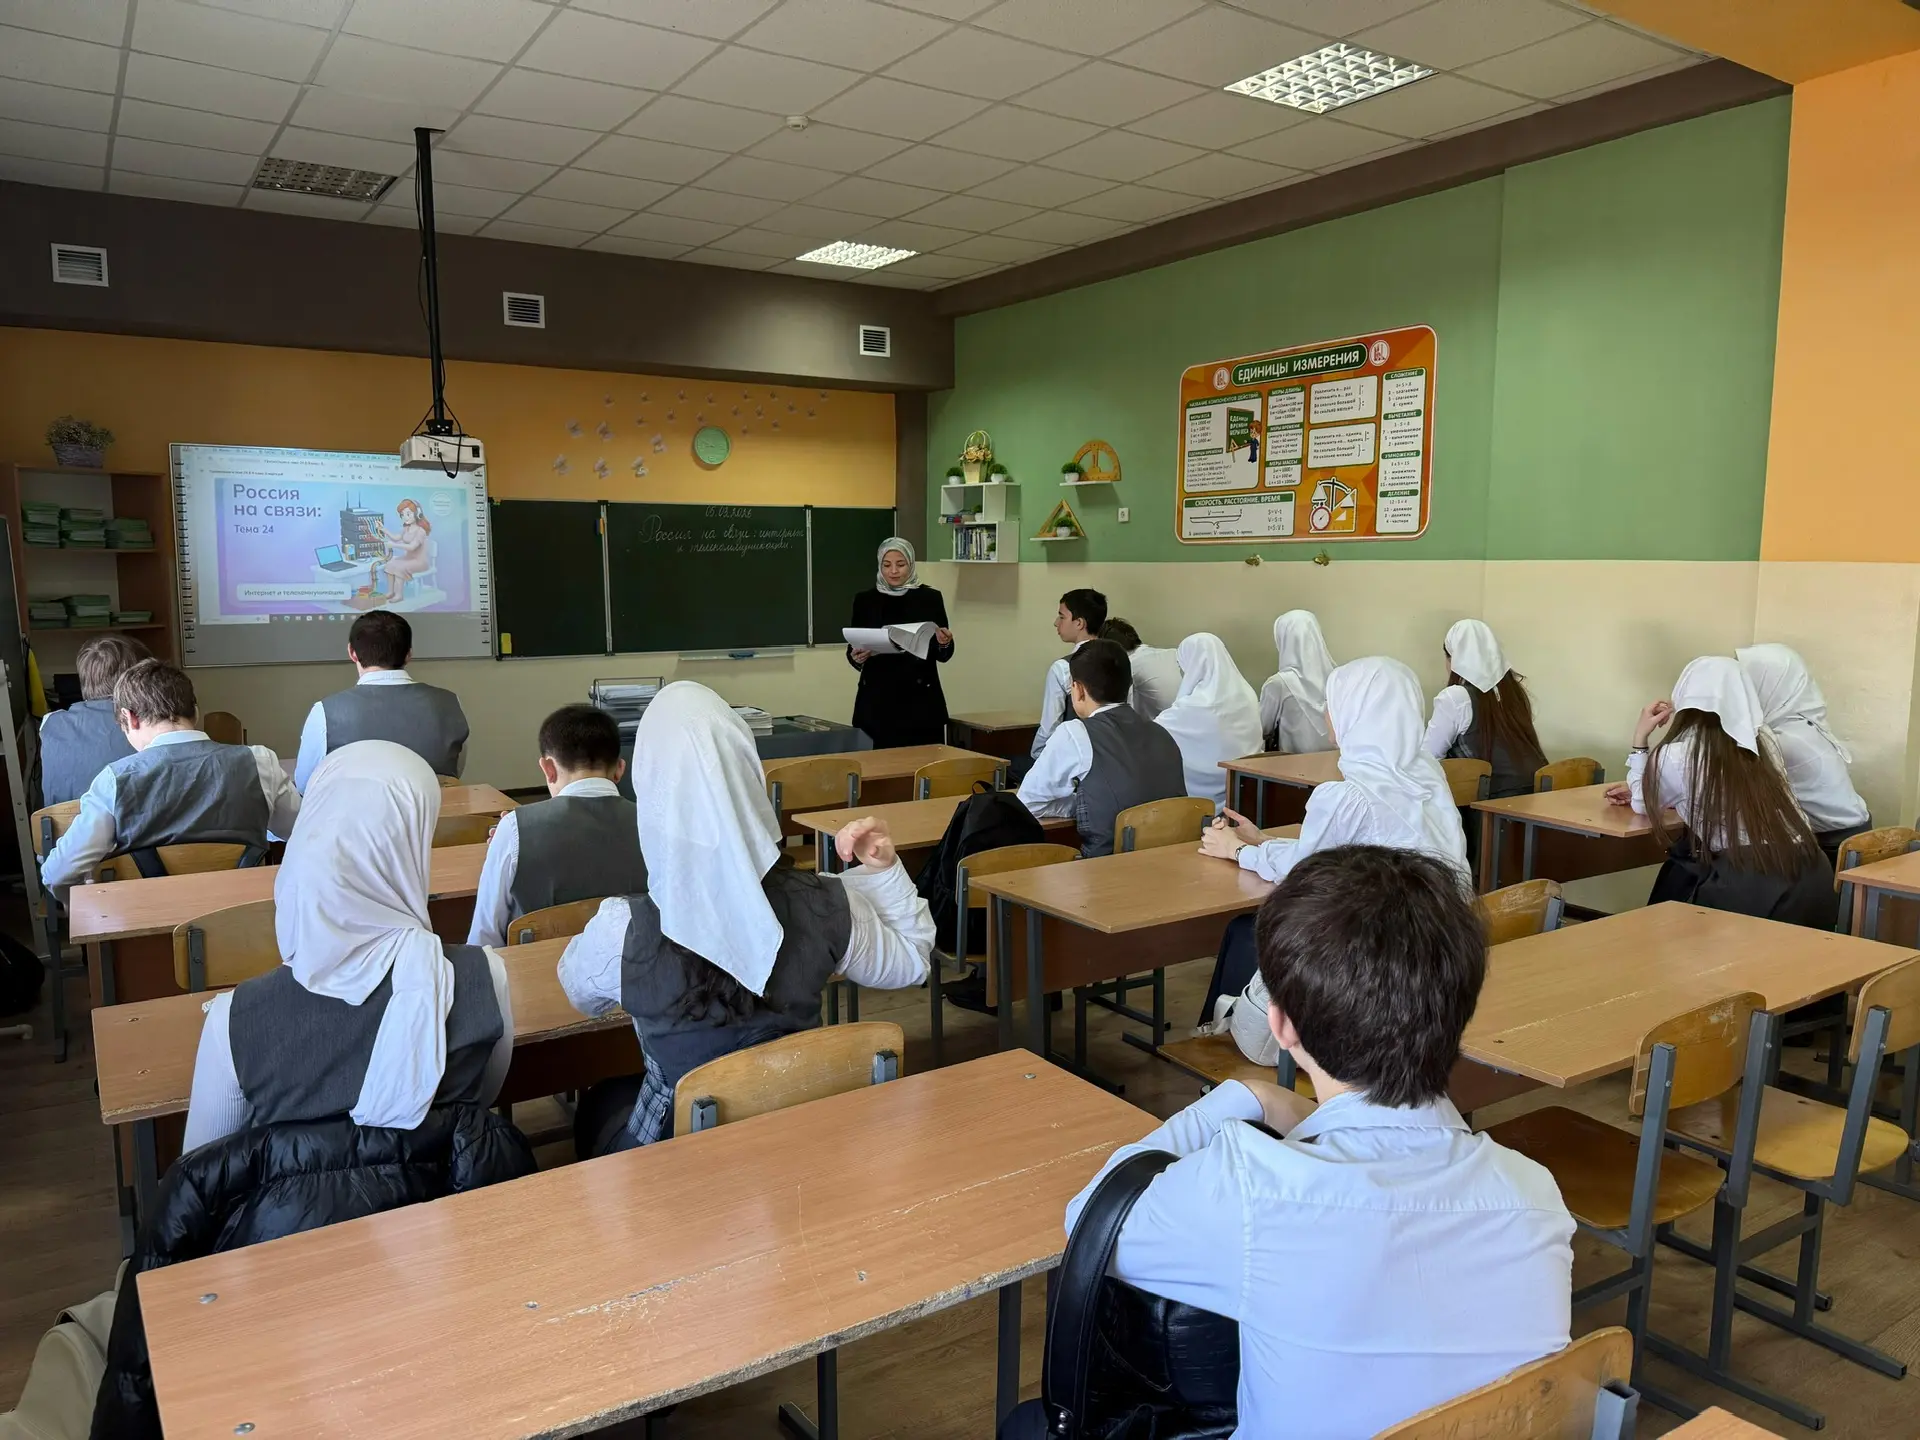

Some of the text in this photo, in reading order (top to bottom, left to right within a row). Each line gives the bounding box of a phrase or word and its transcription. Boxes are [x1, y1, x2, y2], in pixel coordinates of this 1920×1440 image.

[1238, 351, 1359, 382] ЕДИНИЦЫ ИЗМЕРЕНИЯ
[233, 484, 300, 500] Россия
[1224, 497, 1260, 505] РАССТОЯНИЕ.
[234, 504, 322, 517] на связи:
[234, 524, 274, 534] Тема 24
[638, 514, 693, 543] Россия
[701, 528, 716, 539] на
